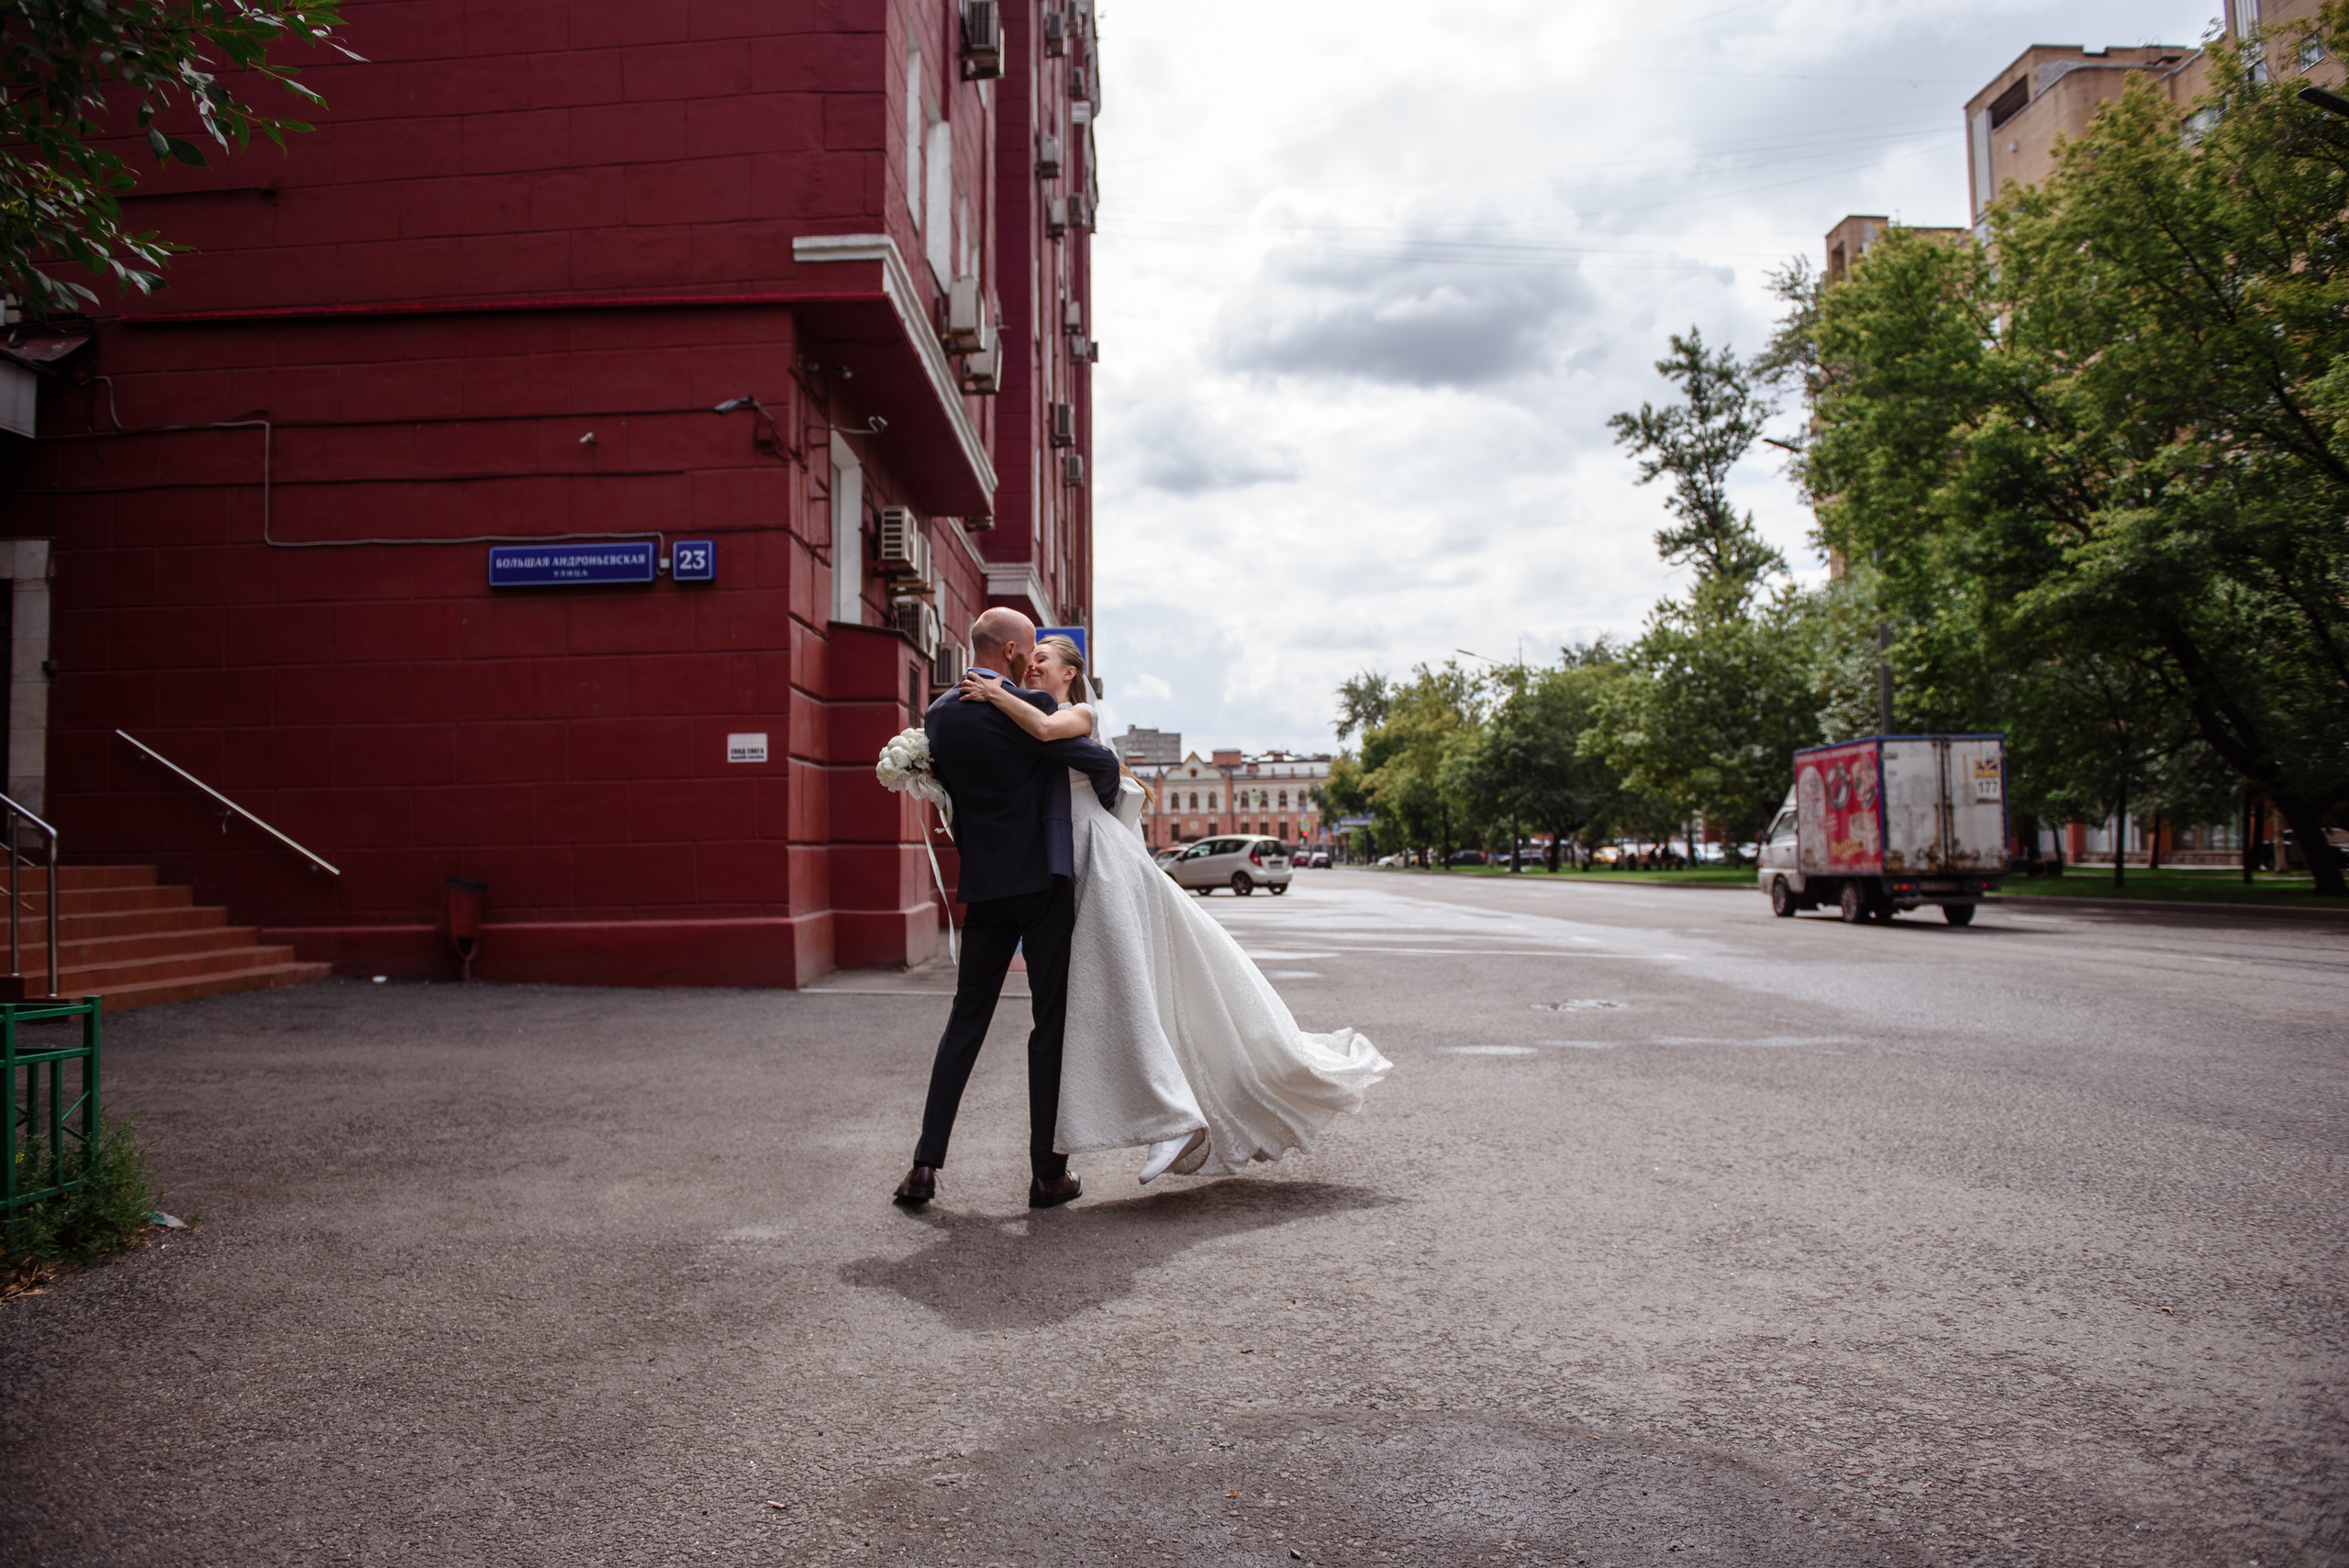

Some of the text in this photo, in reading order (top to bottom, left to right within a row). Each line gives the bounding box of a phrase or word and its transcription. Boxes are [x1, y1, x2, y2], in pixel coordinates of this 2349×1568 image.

[495, 553, 646, 569] БОЛЬШАЯ АНДРОНЬЕВСКАЯ
[679, 550, 706, 570] 23
[553, 570, 588, 578] УЛИЦА
[1978, 781, 1998, 794] 177
